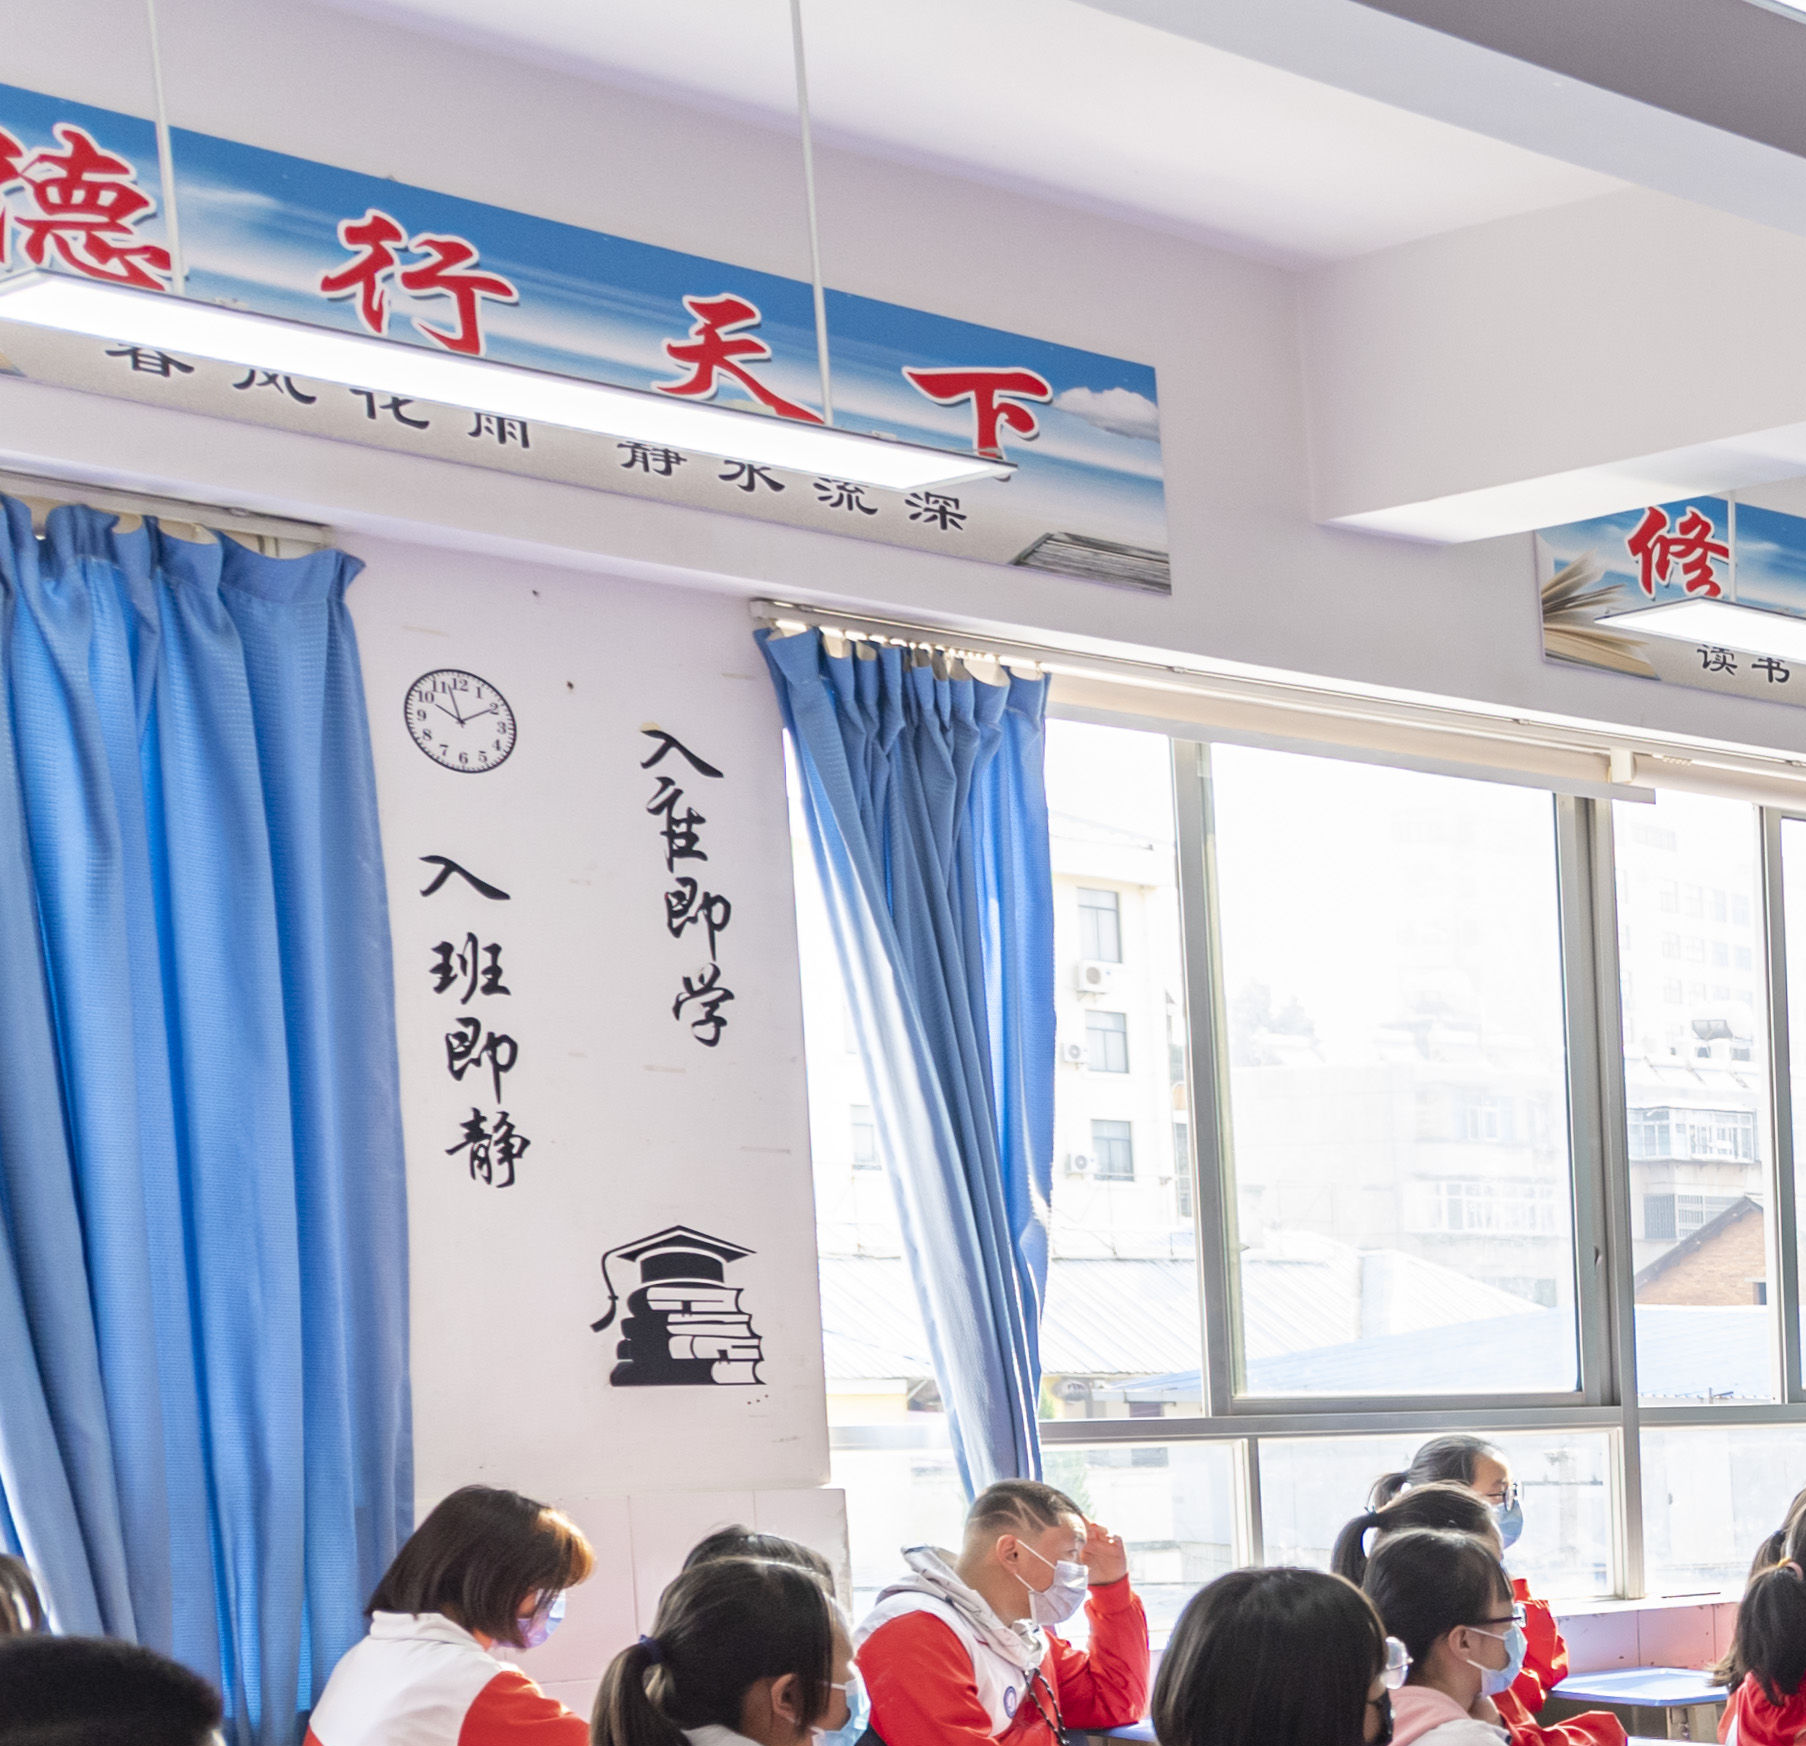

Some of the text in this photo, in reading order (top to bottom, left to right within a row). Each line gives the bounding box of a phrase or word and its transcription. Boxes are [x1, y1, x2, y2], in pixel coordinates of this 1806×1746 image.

[1697, 644, 1791, 683] 读书
[417, 709, 427, 721] 9
[497, 721, 506, 734] 3
[422, 729, 432, 741] 8
[440, 743, 449, 756] 7
[459, 752, 468, 764] 6
[418, 854, 531, 1188] 入班即静
